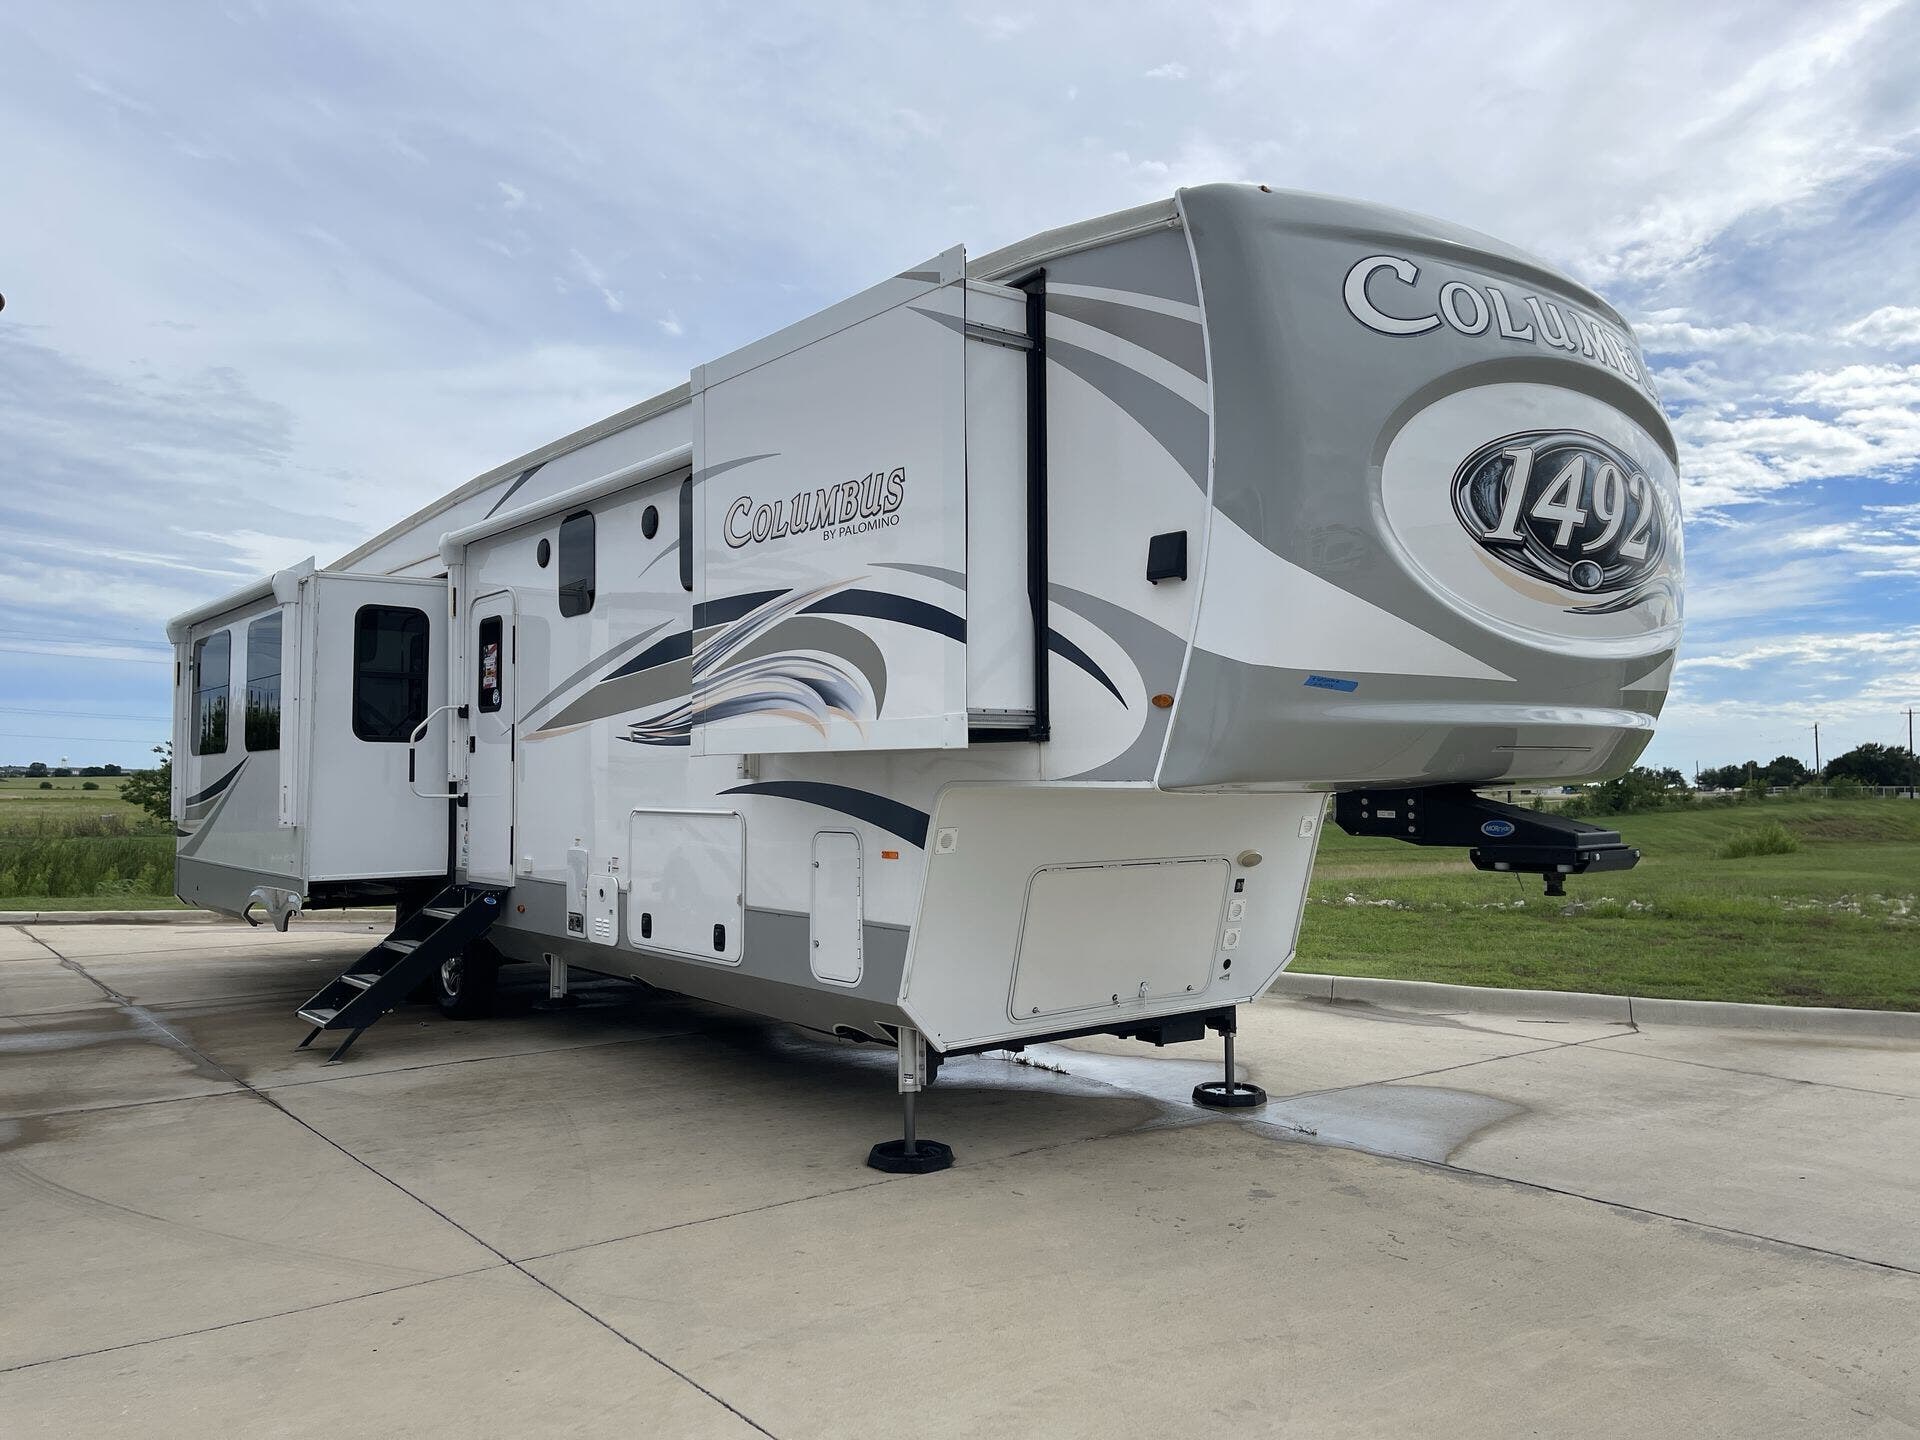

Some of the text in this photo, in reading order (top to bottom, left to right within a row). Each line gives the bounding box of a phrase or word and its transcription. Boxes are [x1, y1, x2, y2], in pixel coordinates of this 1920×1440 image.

[1343, 254, 1665, 409] COLUMBU
[724, 467, 905, 548] COLUMBUS
[822, 514, 900, 541] BY PALOMINO
[1482, 447, 1652, 560] 1492
